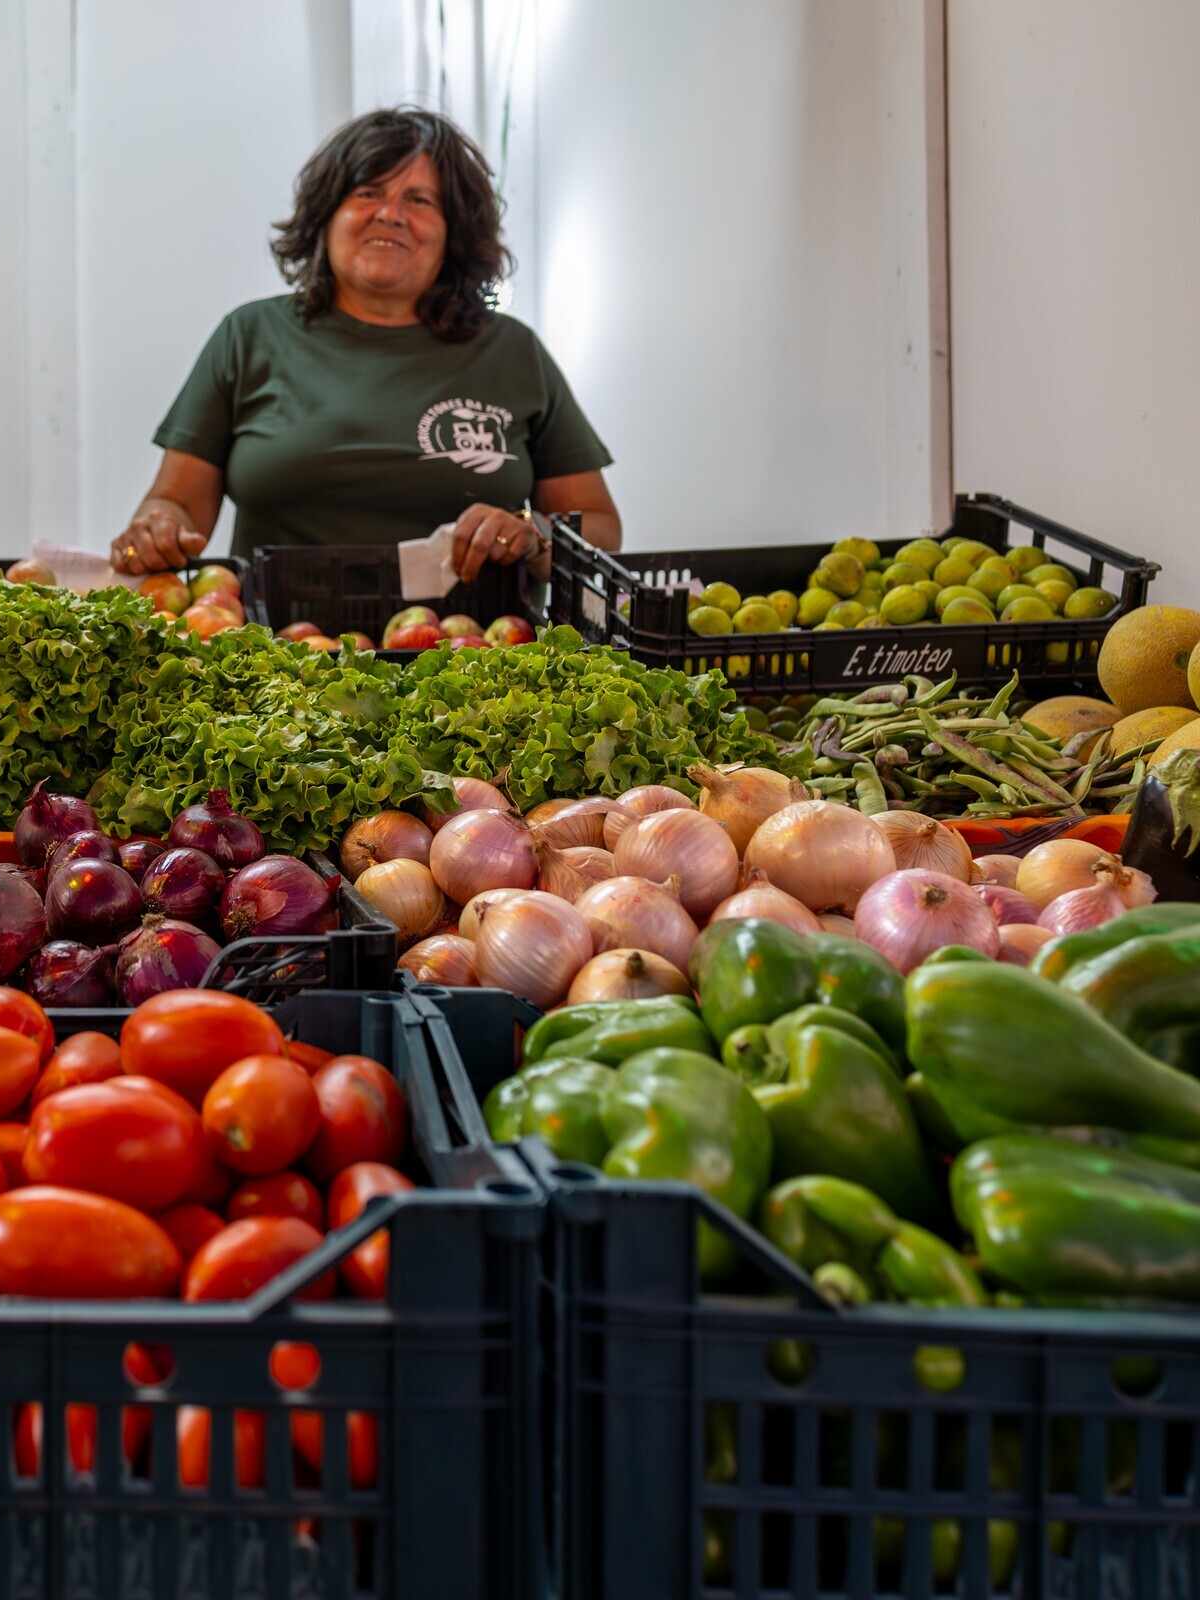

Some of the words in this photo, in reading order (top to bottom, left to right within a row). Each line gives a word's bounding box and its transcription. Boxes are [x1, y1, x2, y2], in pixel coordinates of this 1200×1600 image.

[417, 397, 464, 454] AGRICULTORES
[465, 398, 483, 412] DA
[842, 642, 953, 677] E.timoteo
